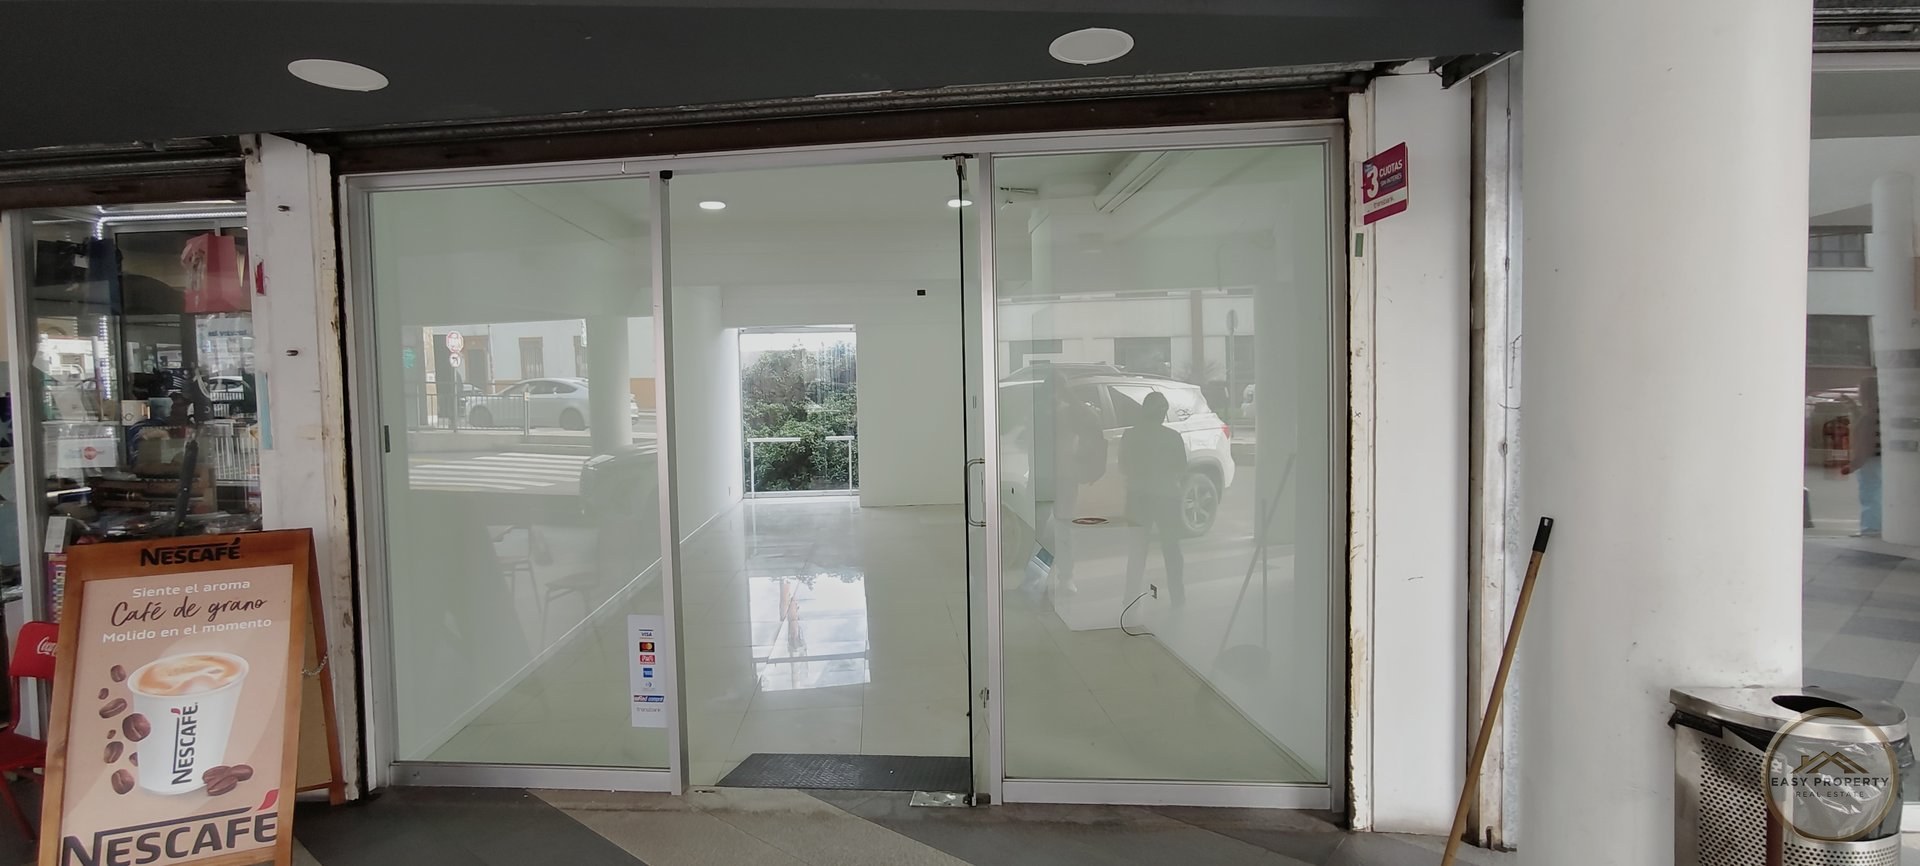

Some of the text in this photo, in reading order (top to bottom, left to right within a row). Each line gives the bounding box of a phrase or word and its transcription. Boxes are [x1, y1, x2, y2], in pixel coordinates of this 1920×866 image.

[1367, 165, 1379, 198] 3
[1379, 160, 1403, 177] CUOTAS
[140, 537, 241, 567] NESCAFÉ
[132, 581, 251, 598] Siente el aroma
[111, 596, 268, 627] Café de grano
[102, 619, 272, 643] Molido en el momento
[171, 703, 198, 785] NESCAFÉ
[62, 789, 279, 866] NESCAFÉ
